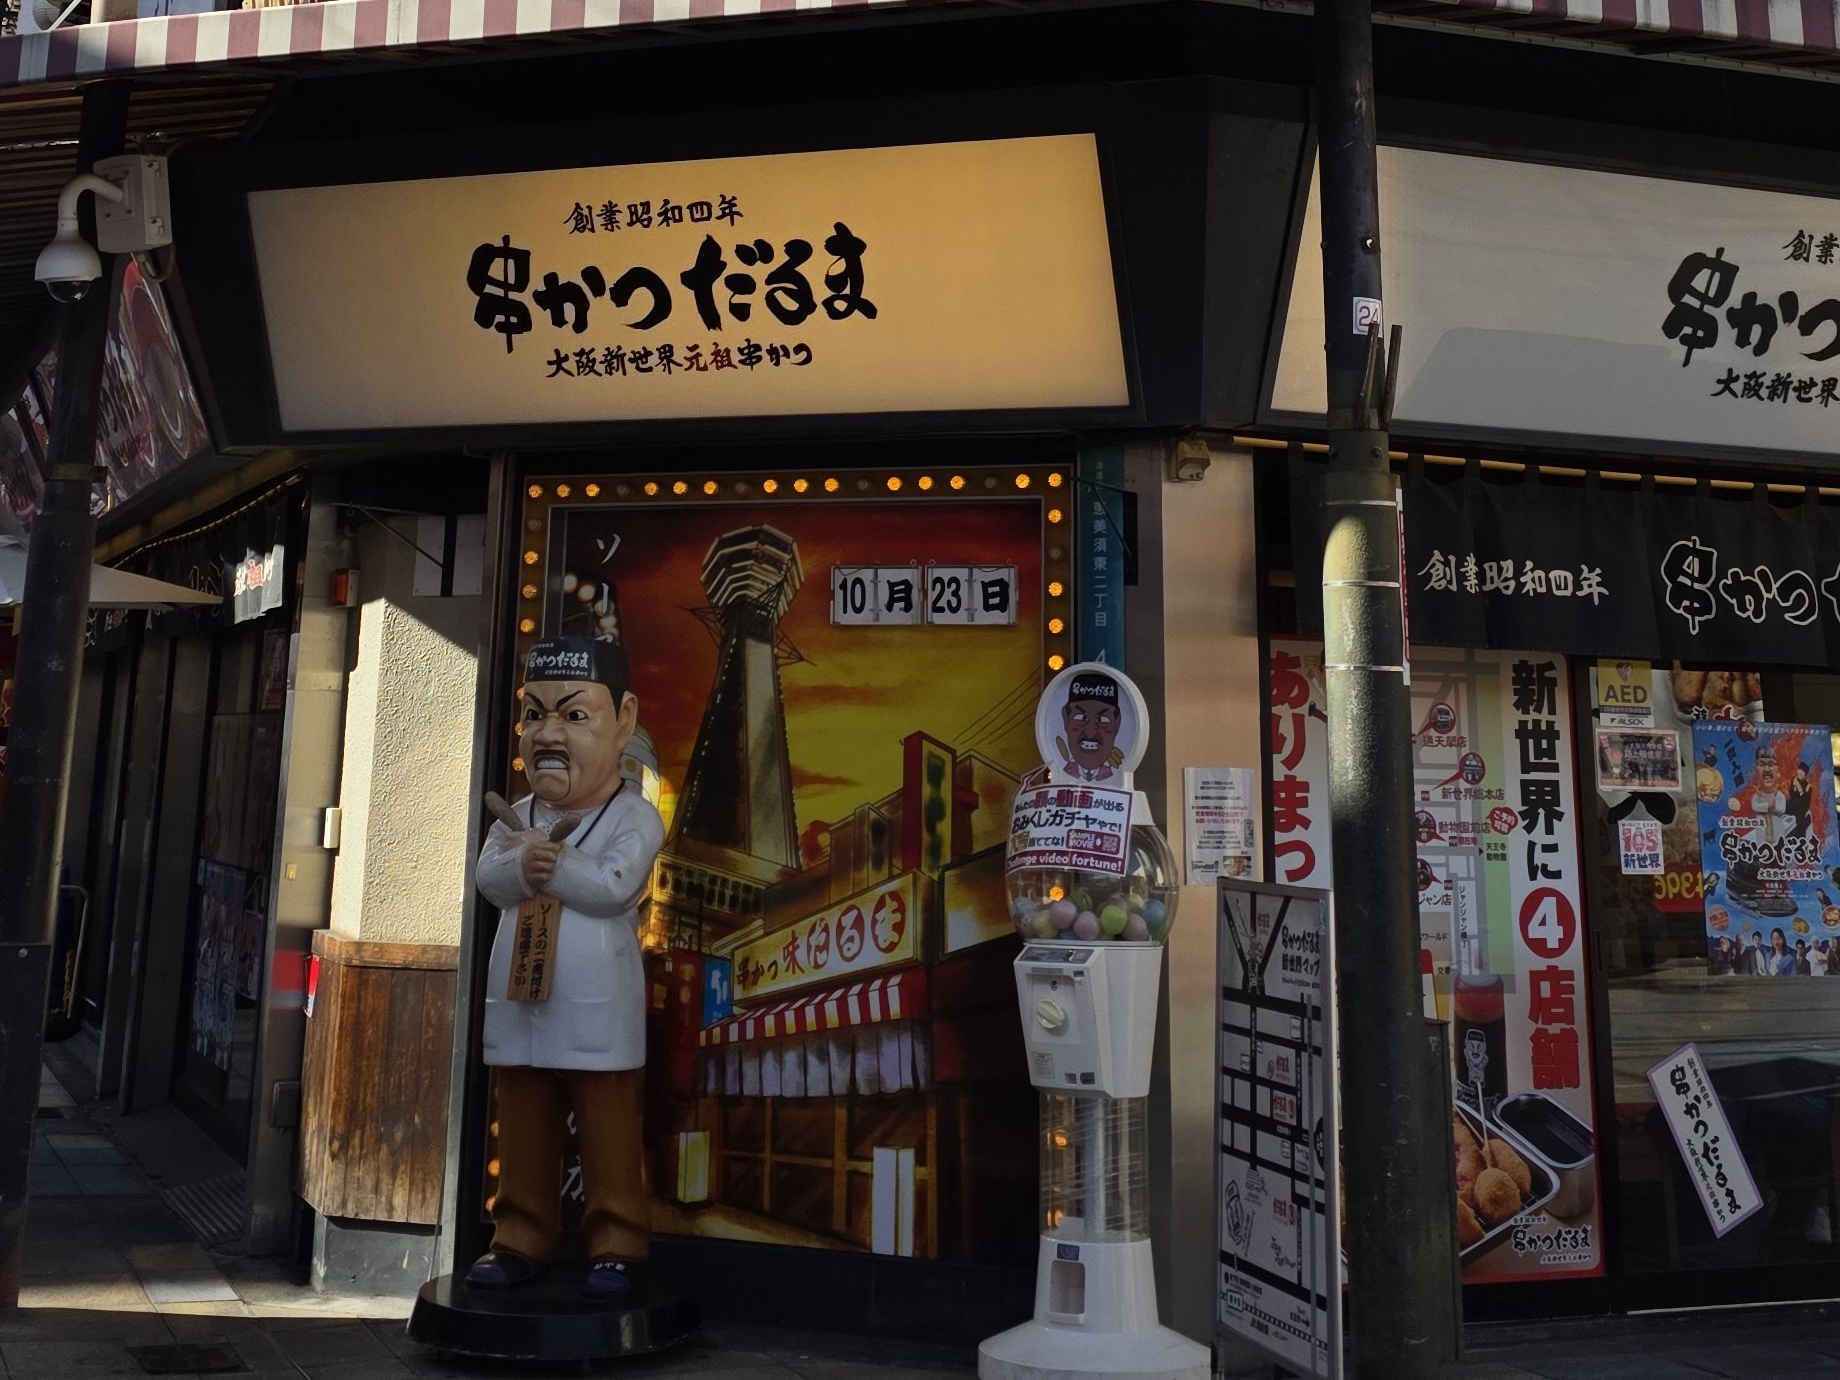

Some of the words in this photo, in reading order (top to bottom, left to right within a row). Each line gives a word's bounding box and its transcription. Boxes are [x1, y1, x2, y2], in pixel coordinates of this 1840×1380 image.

[563, 194, 744, 235] 創業昭和四年
[466, 222, 878, 354] 串かつだるま
[545, 338, 813, 379] 大阪新世界元祖串かつ
[1711, 368, 1840, 408] 大阪新世界
[1417, 549, 1609, 606] 創業昭和四年
[1661, 535, 1840, 635] 串かつ
[1604, 684, 1648, 704] AED
[1040, 852, 1069, 864] video
[1072, 853, 1122, 872] fortune!
[1623, 853, 1661, 869] 新世界
